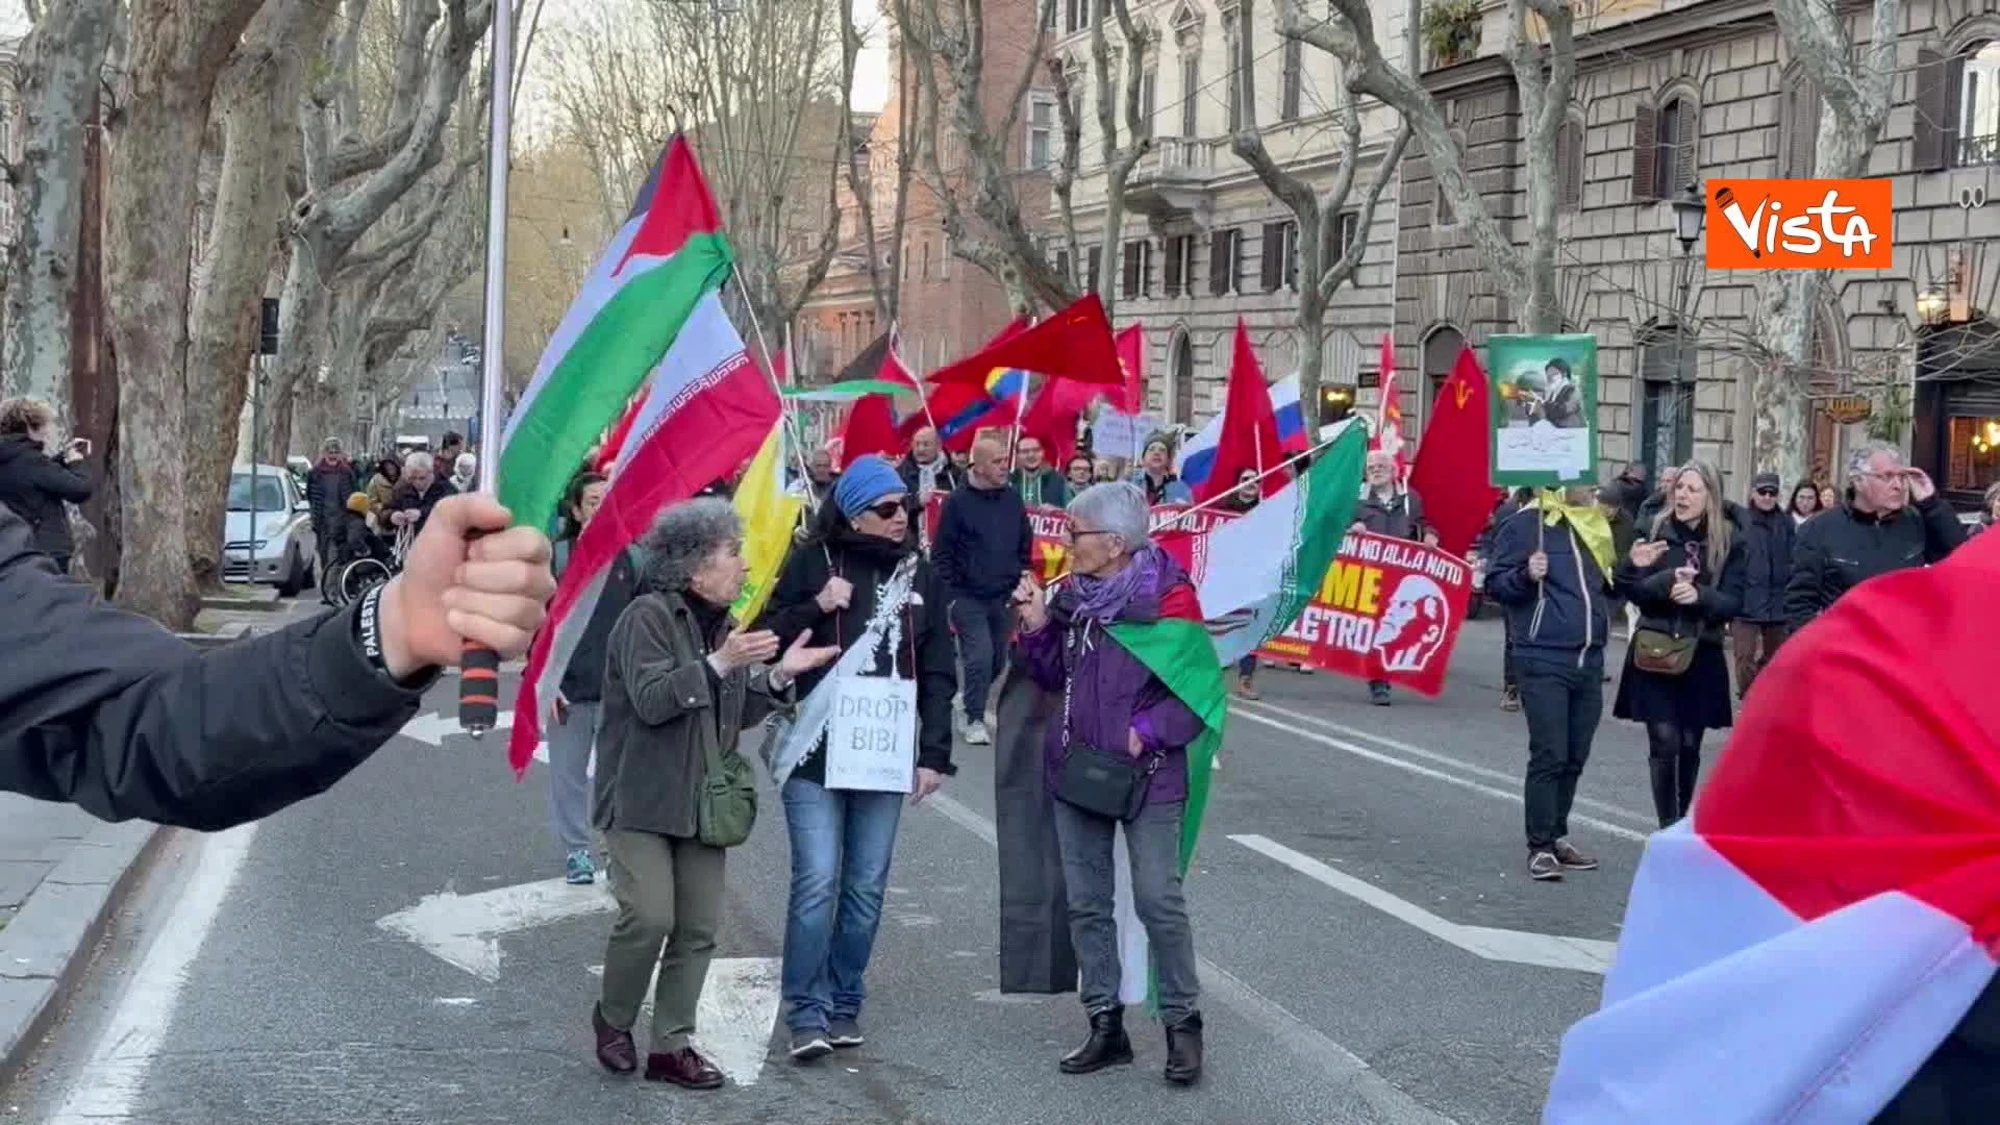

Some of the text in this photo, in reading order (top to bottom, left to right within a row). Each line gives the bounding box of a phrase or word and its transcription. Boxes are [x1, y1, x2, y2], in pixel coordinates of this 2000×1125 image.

[1358, 539, 1382, 561] NO
[1381, 544, 1425, 571] ALLA
[1425, 555, 1464, 585] NATO
[1315, 559, 1384, 614] ME
[840, 694, 908, 722] DROP
[851, 726, 897, 752] BIBI
